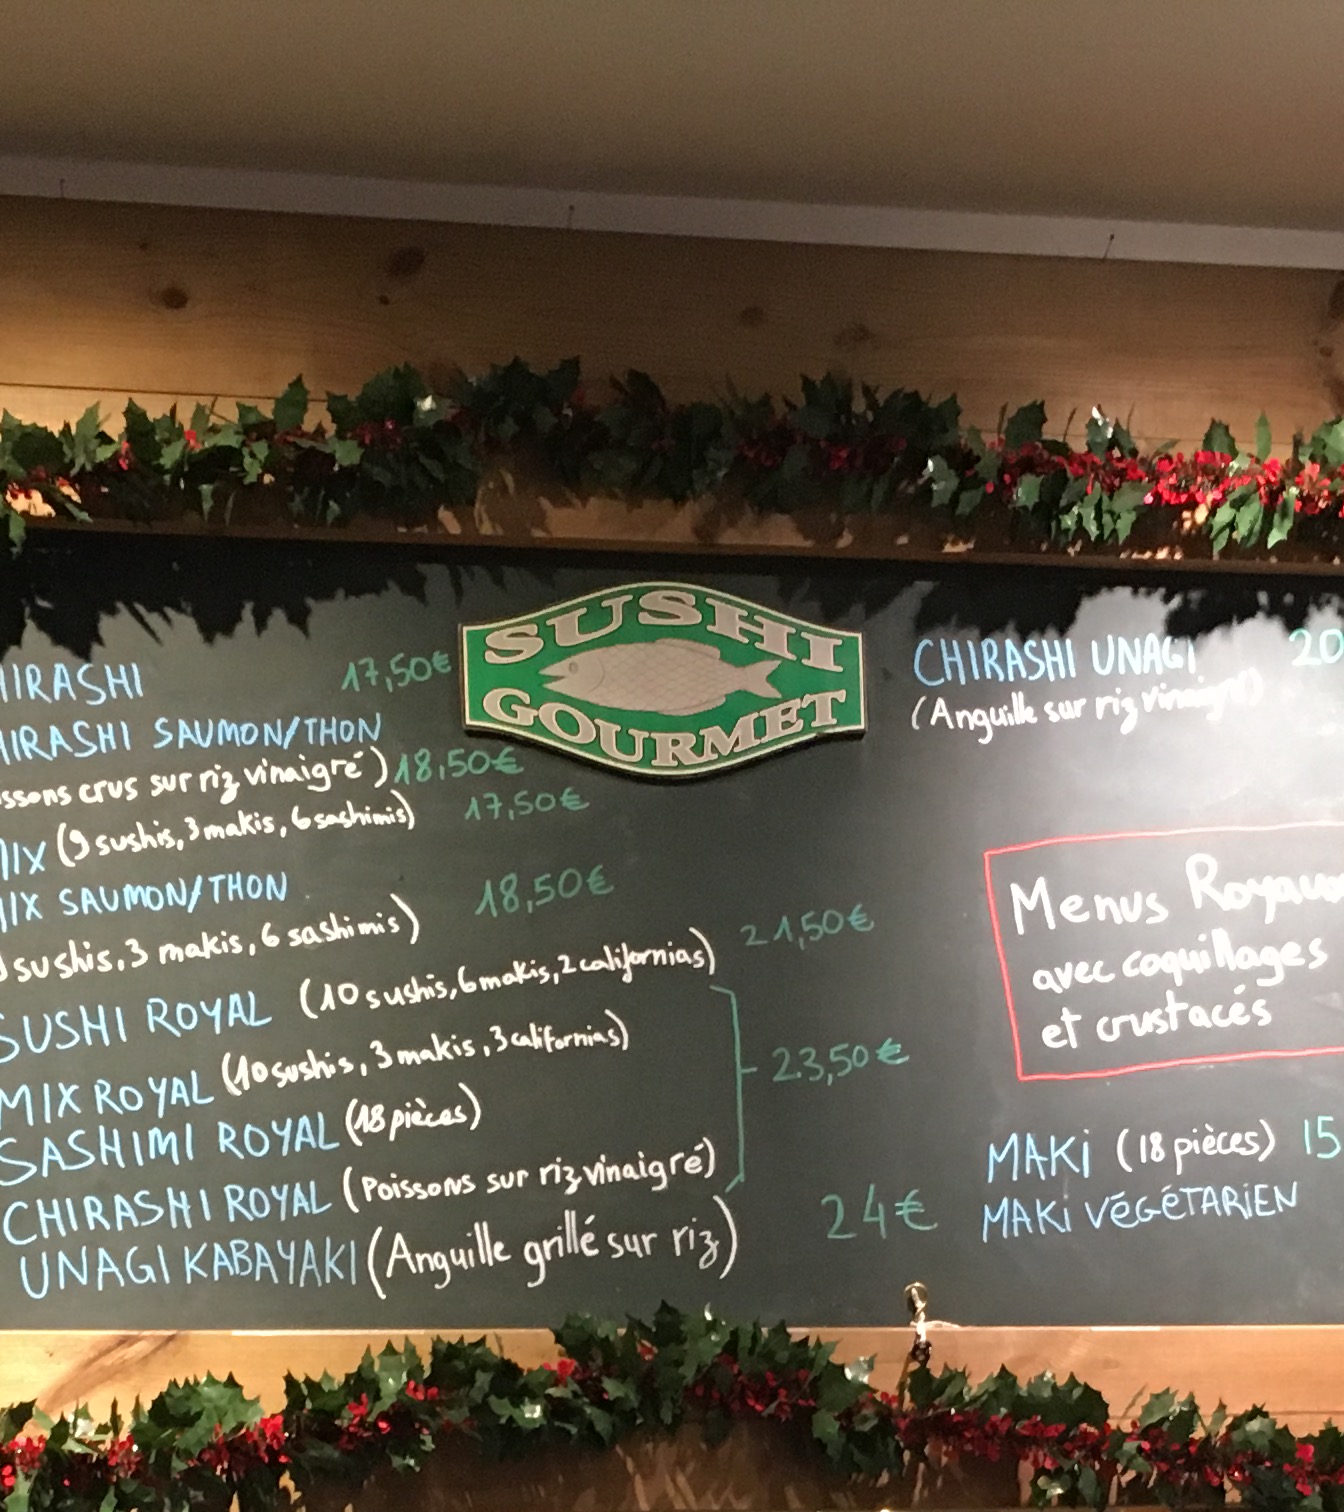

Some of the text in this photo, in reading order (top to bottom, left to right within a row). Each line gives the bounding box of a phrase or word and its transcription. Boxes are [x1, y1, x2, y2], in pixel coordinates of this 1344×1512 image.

[342, 649, 452, 693] 17,50€
[483, 590, 846, 767] SUSHI GOURMET
[914, 638, 1077, 686] CHIRASHI
[912, 692, 1138, 744] (Anguille sur riz
[79, 773, 138, 803] crus
[149, 771, 192, 797] sur
[198, 769, 240, 805] riz
[393, 746, 524, 786] 18,50€
[464, 786, 590, 822] 17,50€
[475, 864, 614, 918] 18,50€
[1010, 876, 1169, 934] Menus
[1033, 928, 1328, 993] avec coquillages
[147, 991, 272, 1038] ROYAL
[1042, 984, 1272, 1048] et crustacés
[772, 1037, 909, 1085] 23,50€
[93, 1070, 214, 1118] ROYAL
[218, 1112, 340, 1160] ROYAL
[3, 1187, 211, 1246] CHIRASHI
[225, 1181, 332, 1223] ROYAL
[487, 1169, 529, 1191] sur
[821, 1184, 938, 1239] 24€
[20, 1196, 738, 1299] UNAGI KABAYAKI (Anguille grillé sur riz)
